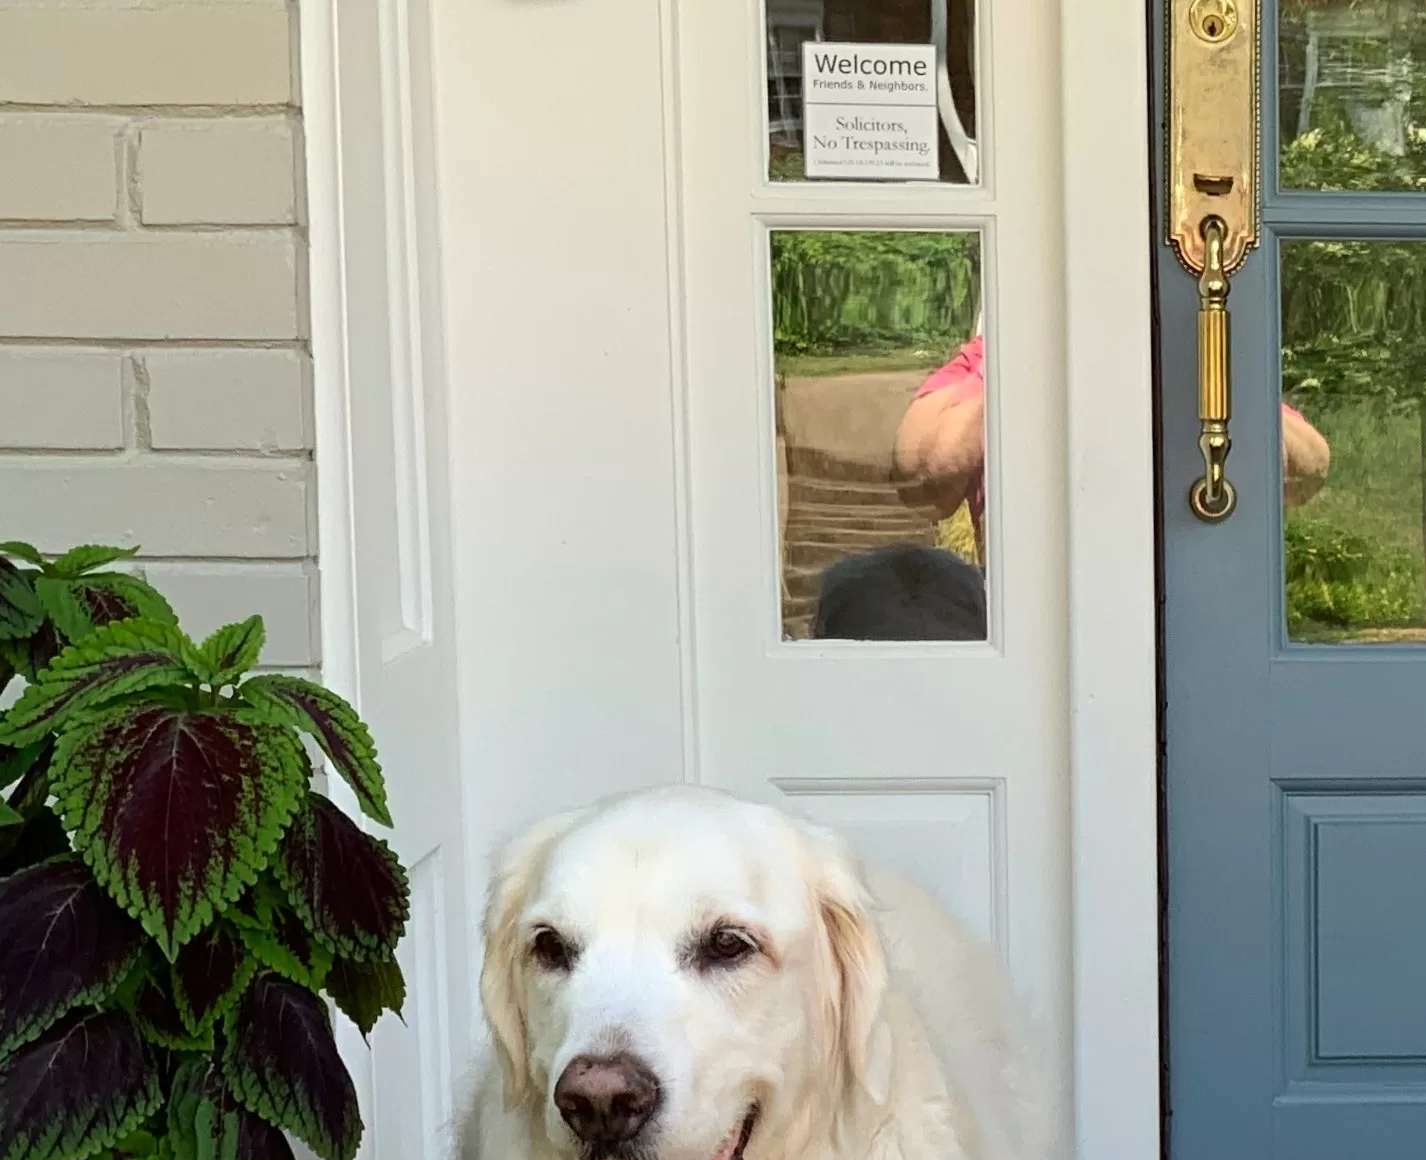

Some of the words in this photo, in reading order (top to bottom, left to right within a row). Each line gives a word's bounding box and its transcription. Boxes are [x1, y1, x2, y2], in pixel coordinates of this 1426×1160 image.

[814, 53, 927, 76] Welcome
[813, 79, 853, 90] Friends
[857, 79, 865, 90] &
[835, 116, 908, 134] Solicitors,
[813, 135, 838, 150] No
